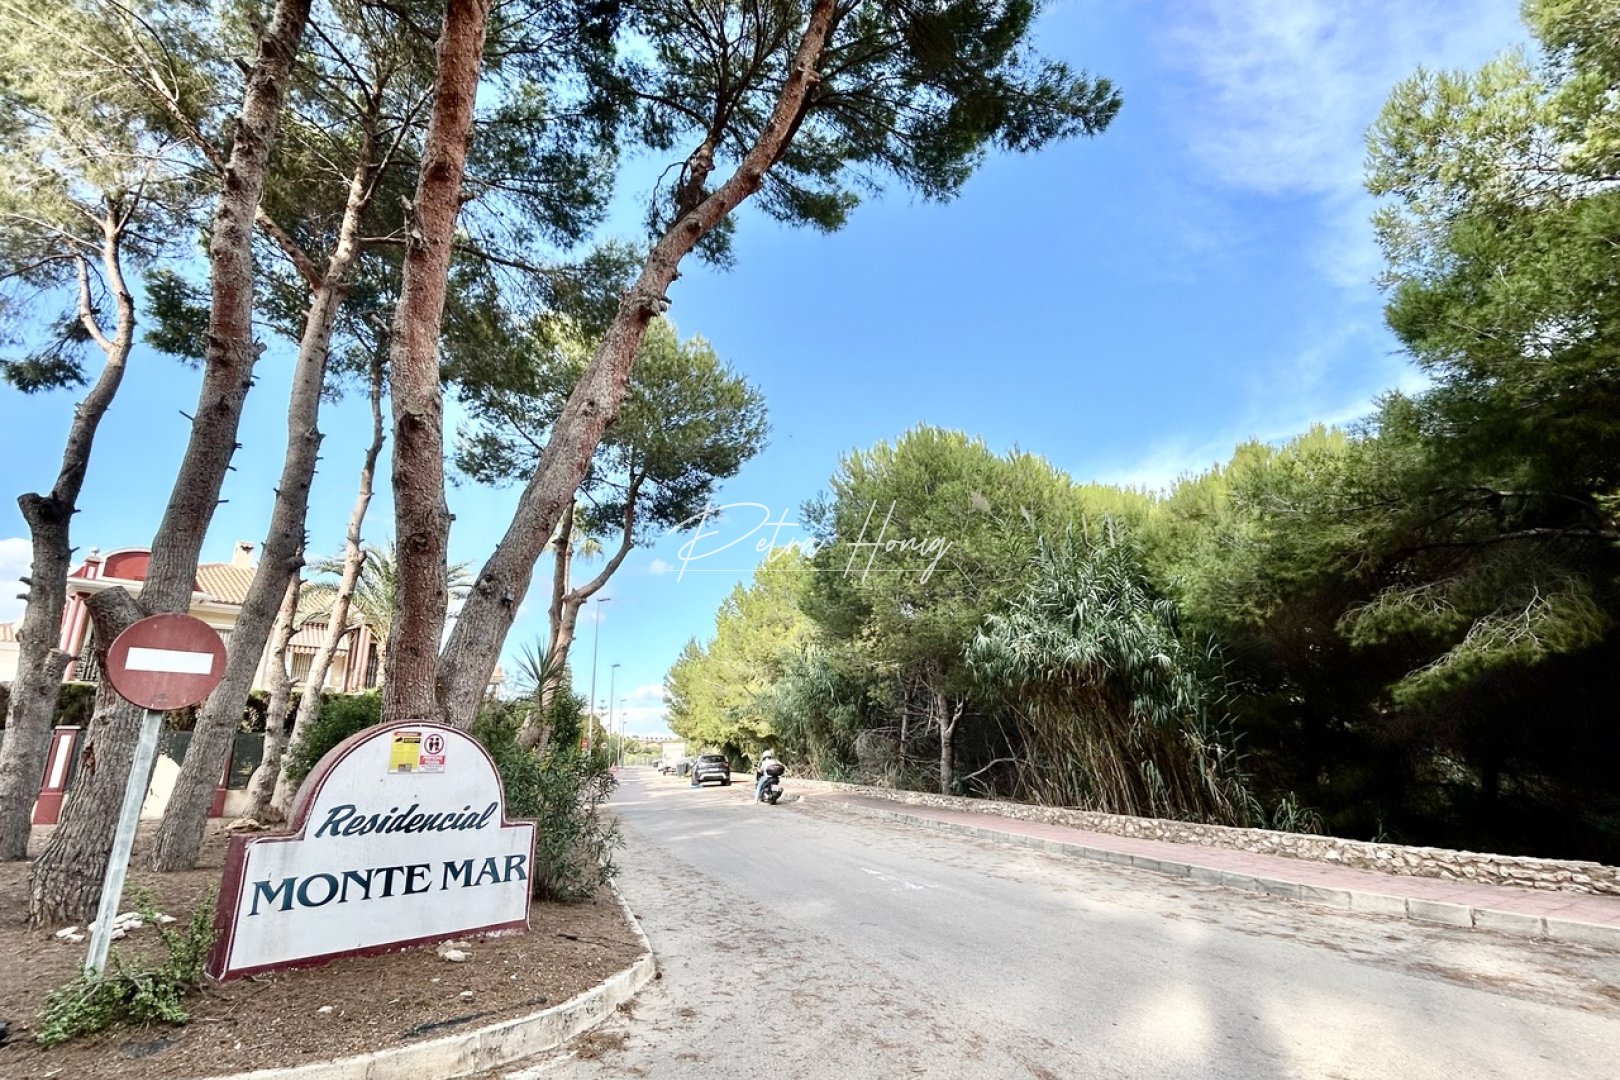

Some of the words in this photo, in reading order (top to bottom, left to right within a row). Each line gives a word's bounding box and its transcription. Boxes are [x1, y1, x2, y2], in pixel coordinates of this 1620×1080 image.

[315, 802, 498, 838] Residencial
[248, 863, 433, 916] MONTE
[441, 853, 528, 891] MAR
